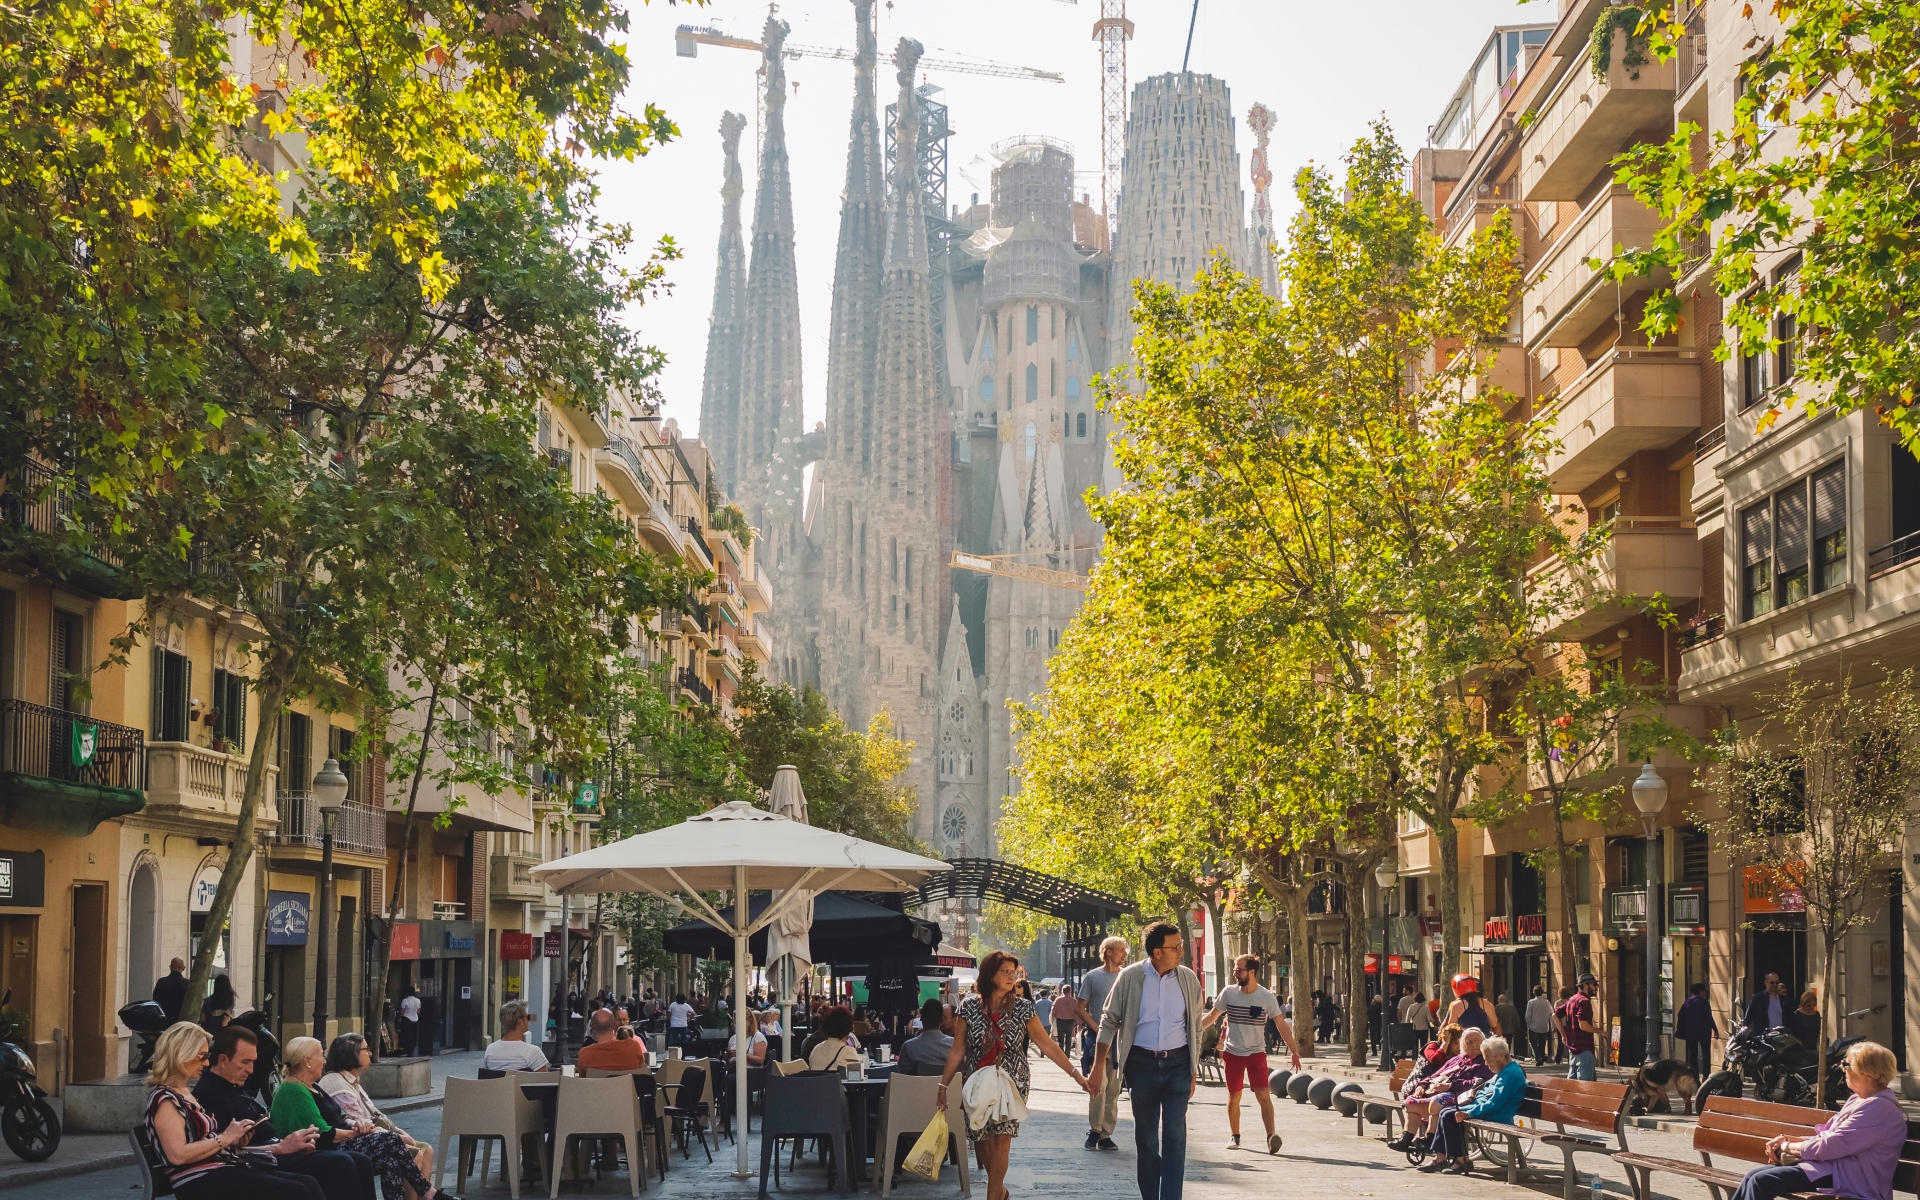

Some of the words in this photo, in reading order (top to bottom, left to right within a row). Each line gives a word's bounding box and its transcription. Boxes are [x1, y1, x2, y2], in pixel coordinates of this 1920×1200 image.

[1485, 921, 1509, 939] DIVAN
[1517, 915, 1543, 935] DIVAN
[506, 940, 529, 950] Halcón
